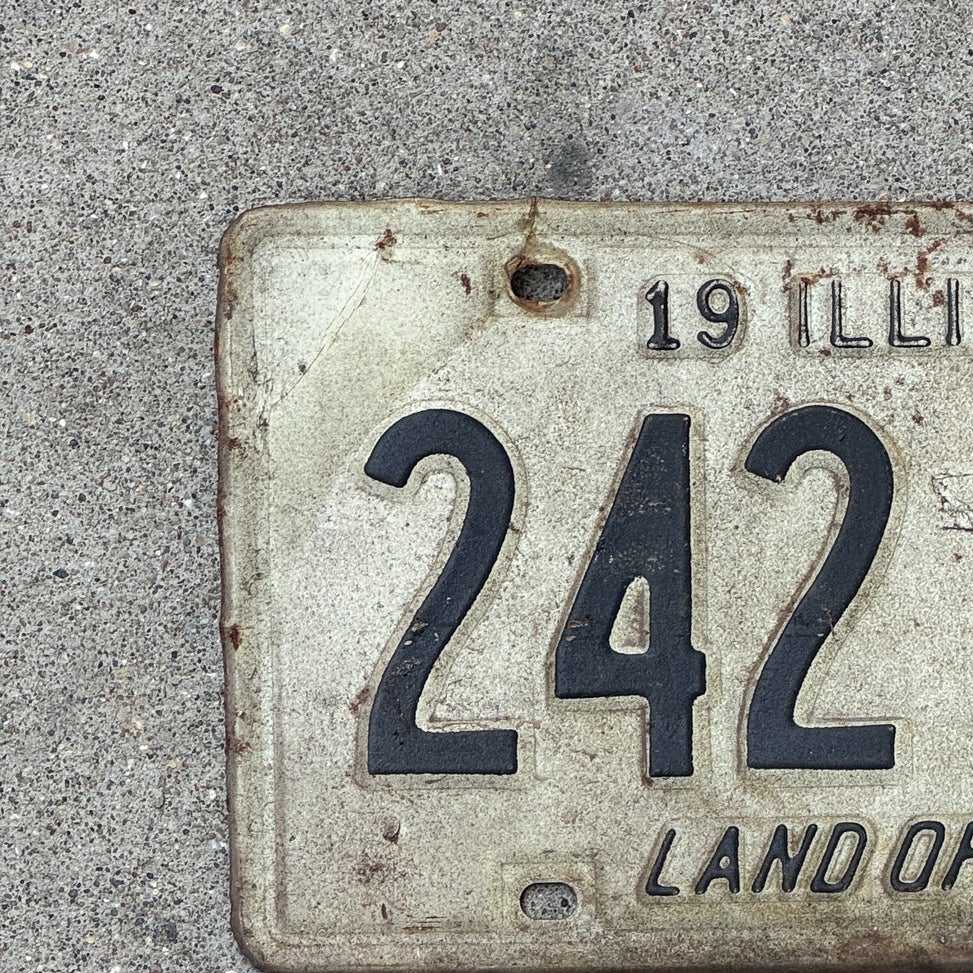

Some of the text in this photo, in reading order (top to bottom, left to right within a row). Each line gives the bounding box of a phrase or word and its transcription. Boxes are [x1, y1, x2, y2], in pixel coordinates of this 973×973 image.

[644, 278, 741, 352] 19
[363, 404, 898, 781] 242
[644, 821, 869, 898] LAND
